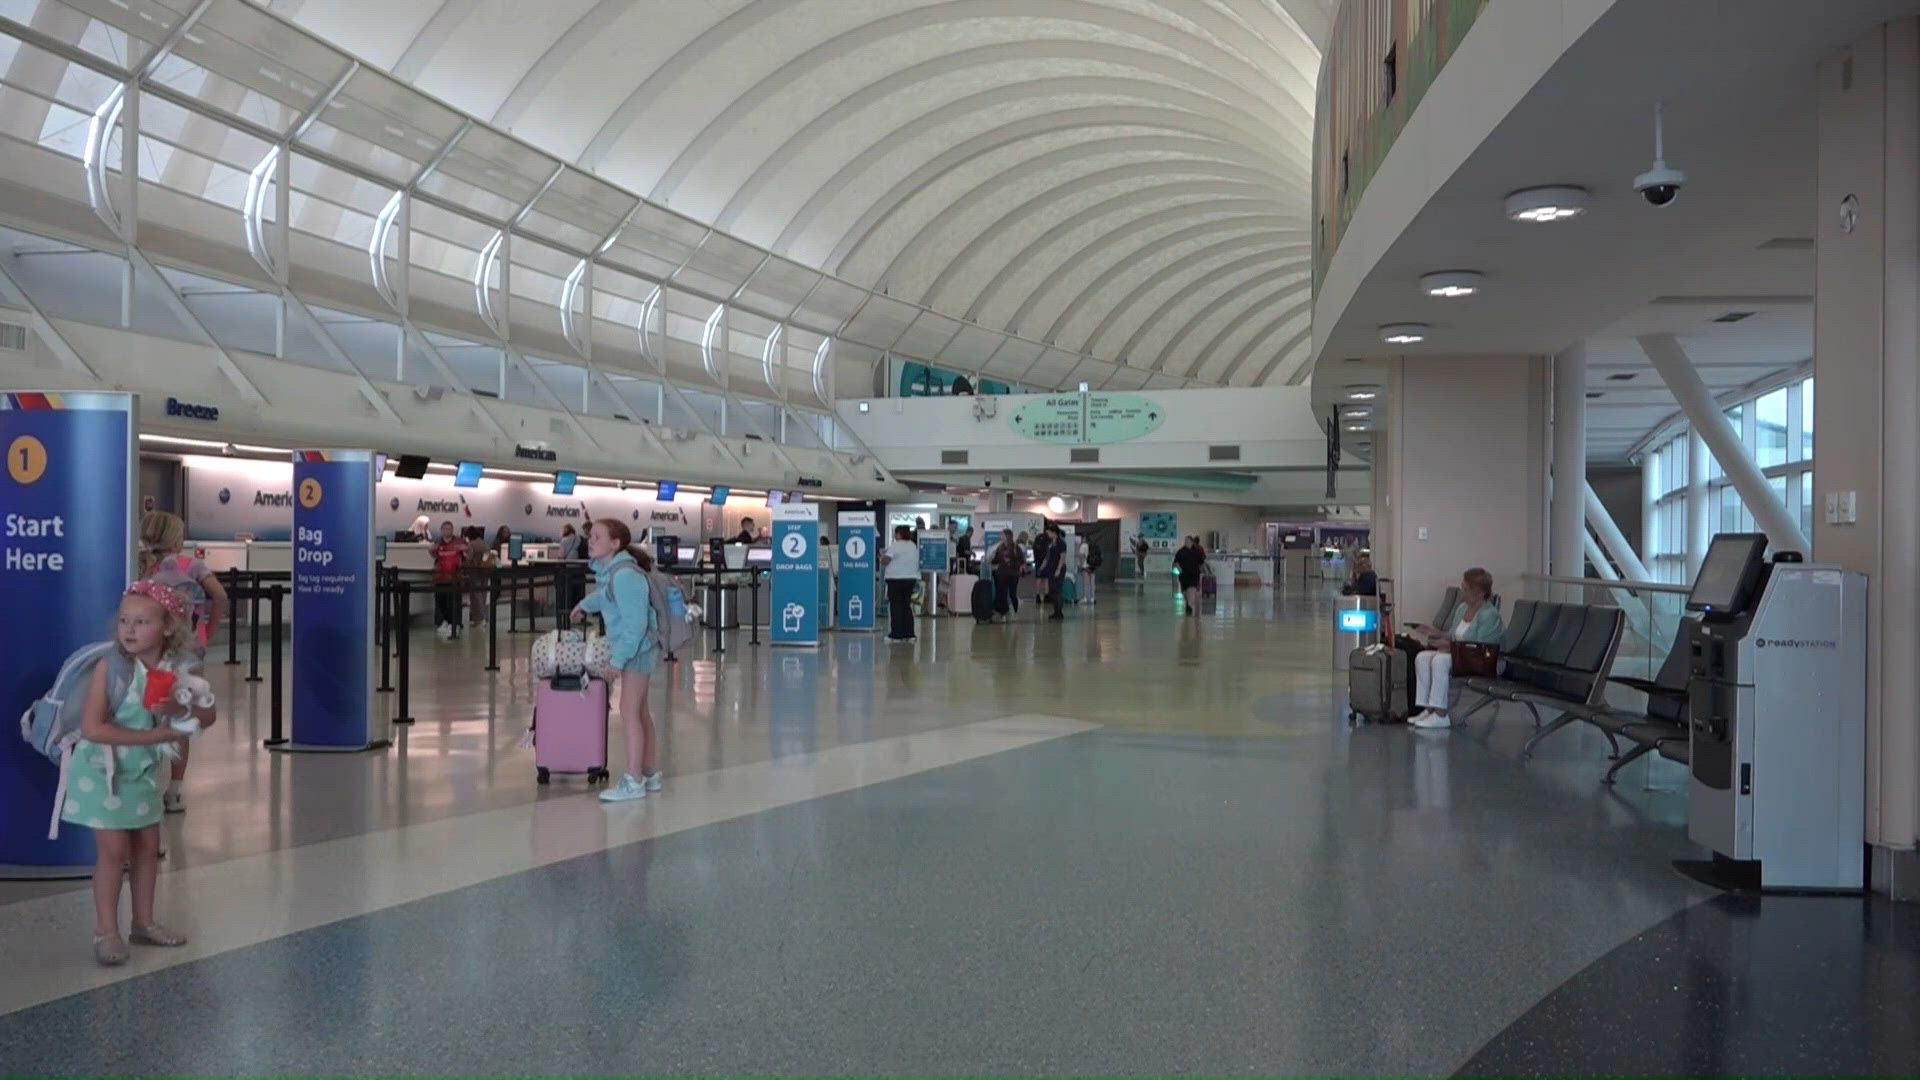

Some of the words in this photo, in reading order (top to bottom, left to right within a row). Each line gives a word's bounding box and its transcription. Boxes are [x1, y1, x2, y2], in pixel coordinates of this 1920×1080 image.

[166, 397, 219, 421] Breeze
[19, 447, 29, 471] 1
[515, 444, 556, 461] American
[253, 490, 294, 507] Americ
[305, 485, 314, 500] 2
[417, 498, 459, 513] American
[546, 504, 580, 517] American
[650, 508, 679, 521] American
[5, 513, 64, 537] Start
[298, 526, 323, 545] Bag
[789, 536, 800, 553] 2
[852, 541, 858, 555] 1
[5, 547, 64, 571] Here
[298, 547, 334, 566] Drop
[321, 574, 356, 583] required
[313, 585, 322, 593] ID
[322, 585, 345, 595] ready
